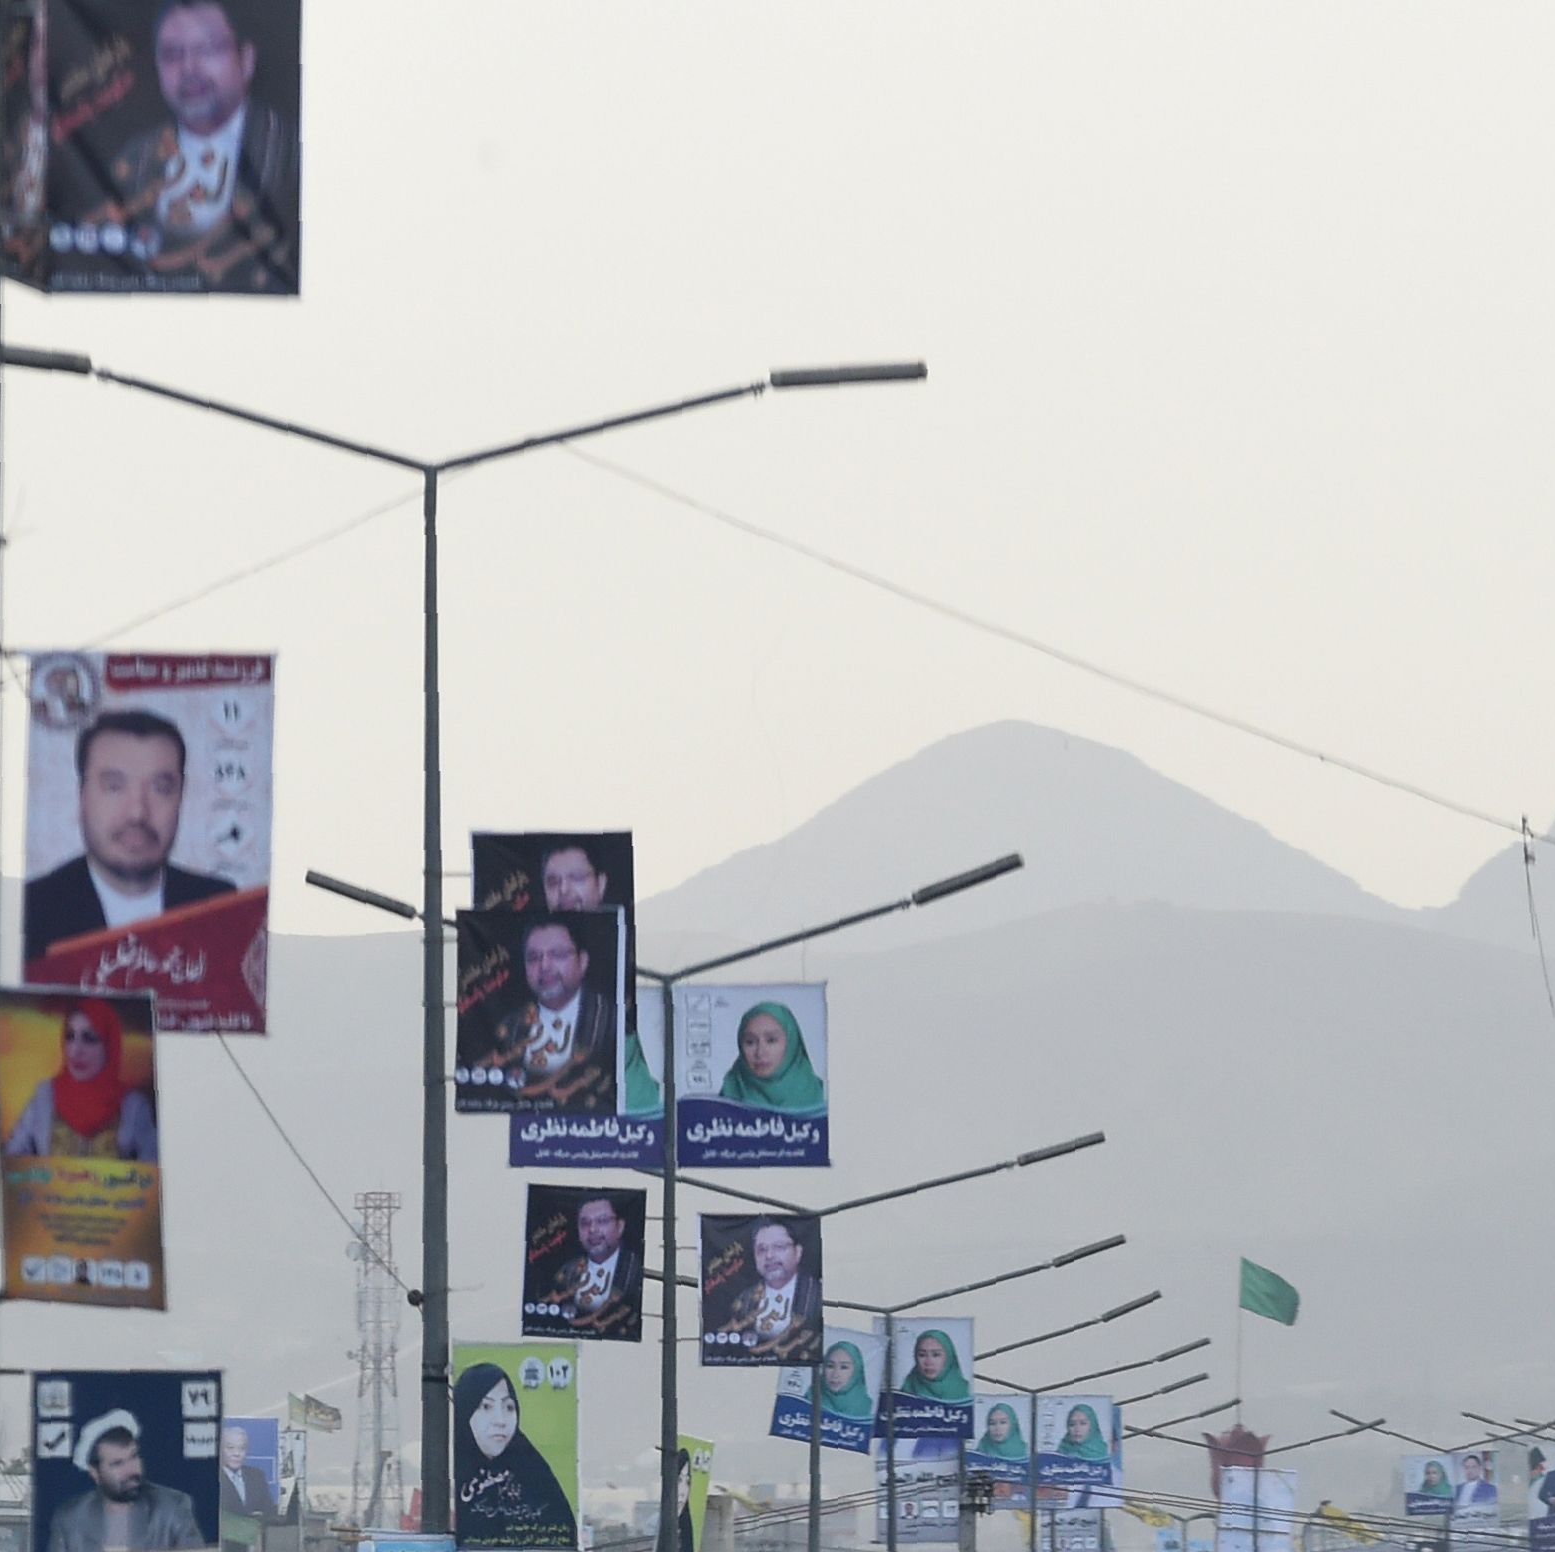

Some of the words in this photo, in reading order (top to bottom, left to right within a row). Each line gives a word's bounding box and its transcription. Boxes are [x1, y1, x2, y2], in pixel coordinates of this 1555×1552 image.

[520, 1115, 568, 1141] نظری
[569, 1115, 620, 1139] فاطمه
[617, 1122, 655, 1145] وکیل
[686, 1115, 735, 1141] نظری
[735, 1115, 785, 1138] فاطمه
[784, 1121, 820, 1144] وکیل
[549, 1365, 569, 1379] ۱۰۲
[187, 1390, 211, 1406] ۷۹
[778, 1412, 810, 1429] نظری
